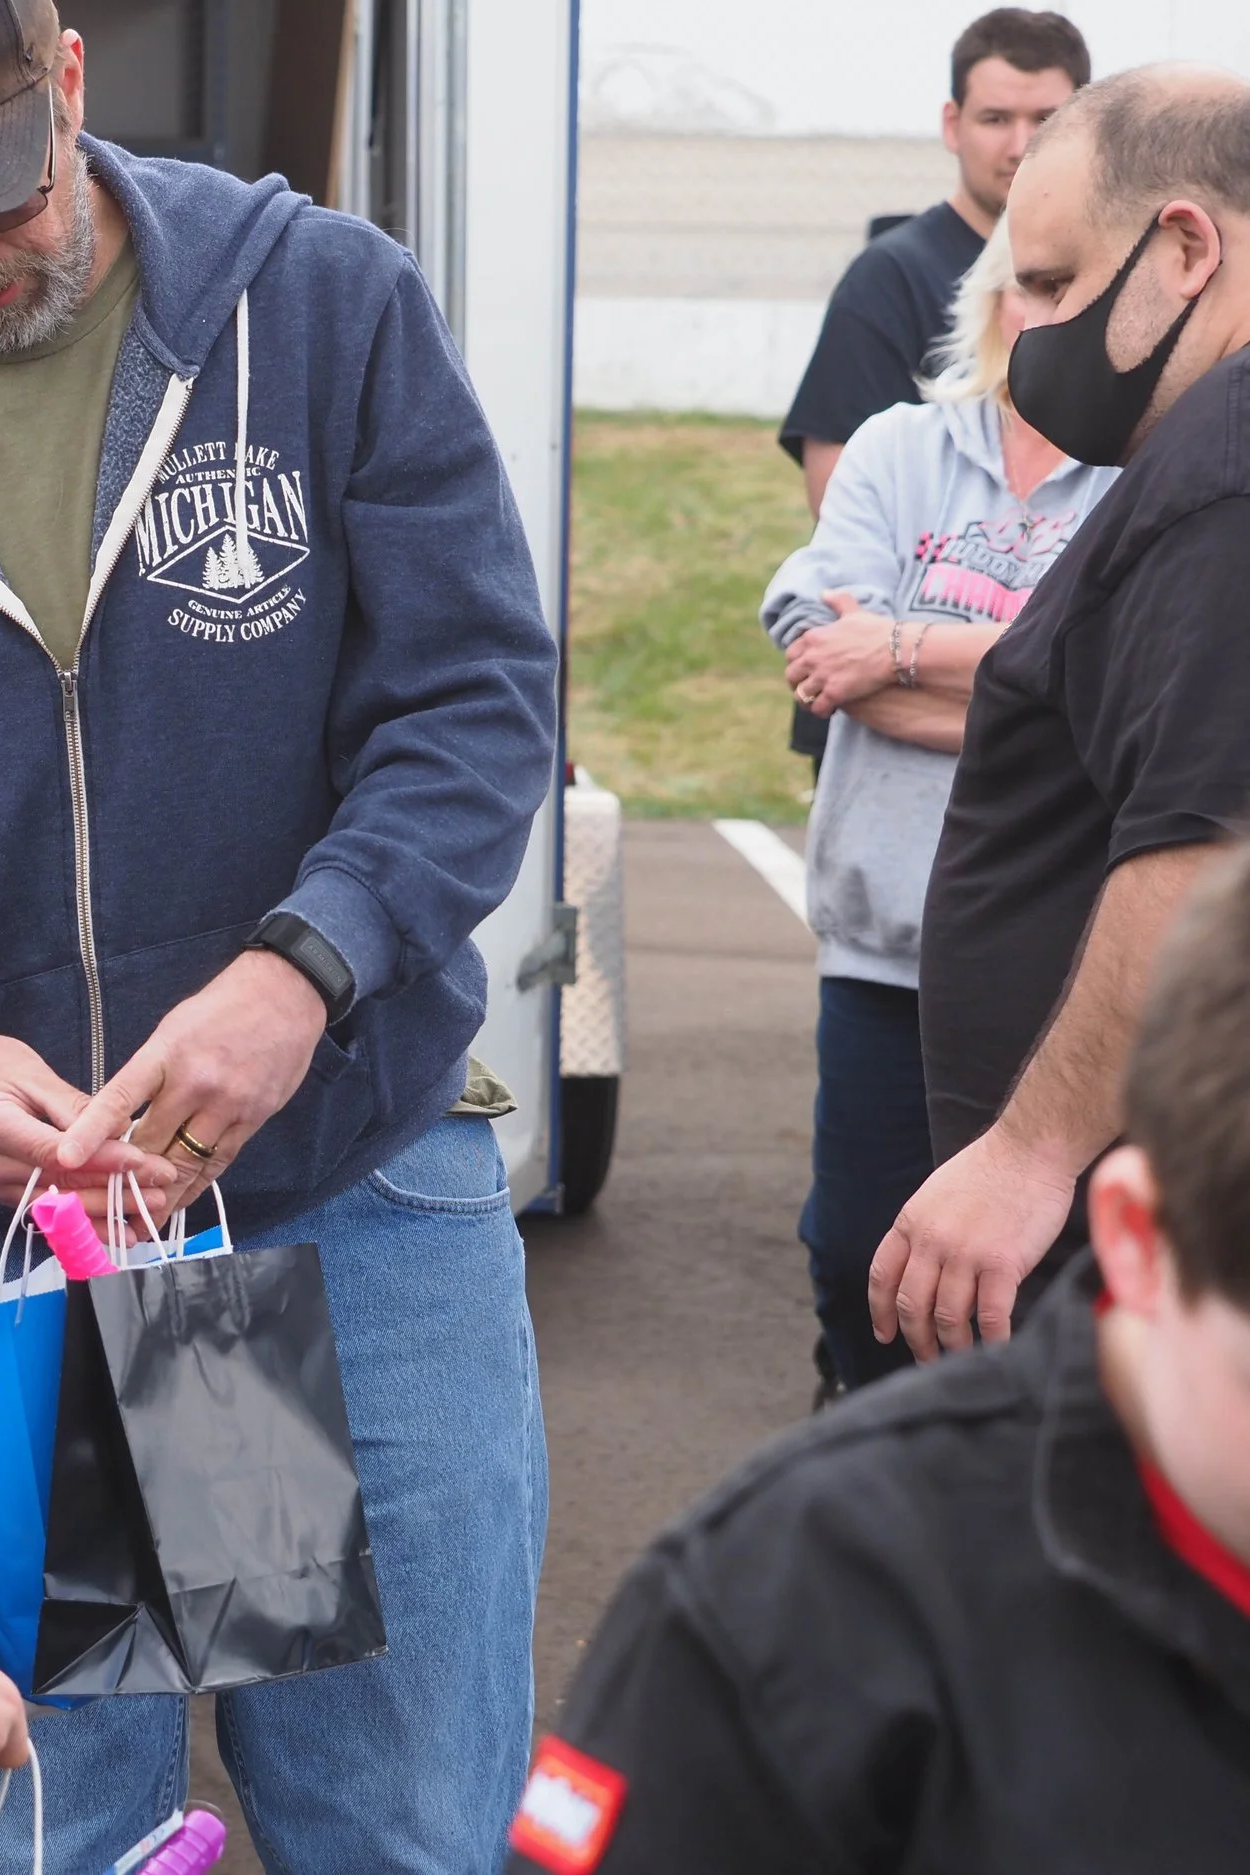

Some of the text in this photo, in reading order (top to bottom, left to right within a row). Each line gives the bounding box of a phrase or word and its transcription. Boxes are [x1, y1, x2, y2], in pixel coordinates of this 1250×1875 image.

[158, 441, 226, 484] MULLETT
[175, 467, 261, 484] AUTHENIC
[134, 470, 308, 576] MICHIGAN
[167, 588, 307, 643] SUPPLY COMPANY
[187, 585, 292, 619] GENUINE ARTICLE
